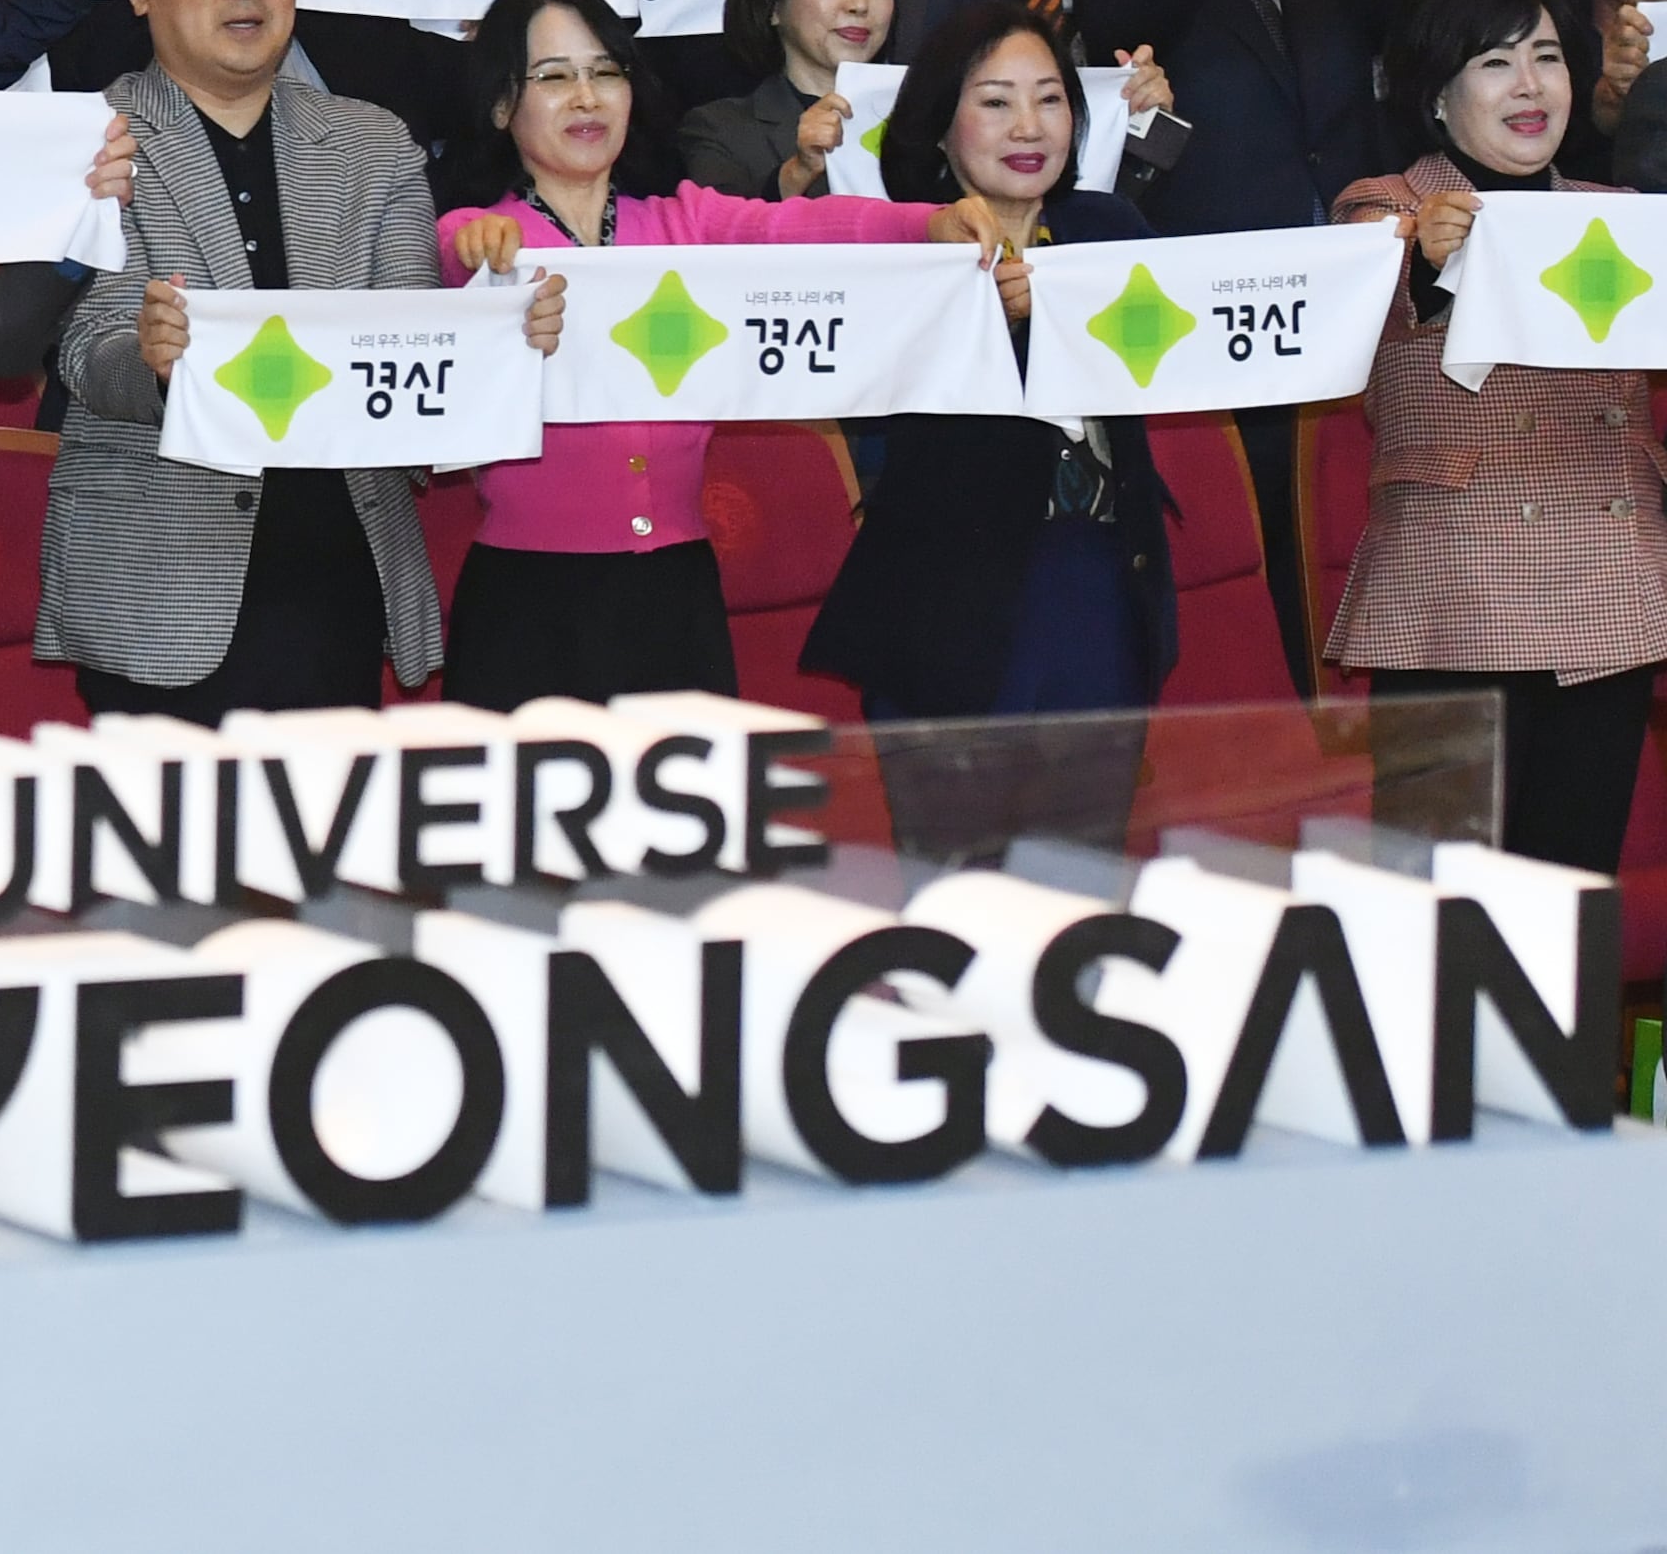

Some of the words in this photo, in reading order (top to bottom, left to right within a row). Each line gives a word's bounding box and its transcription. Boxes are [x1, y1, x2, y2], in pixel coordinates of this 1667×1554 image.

[746, 318, 843, 375] 경산
[1213, 300, 1306, 361] 경산
[351, 360, 453, 419] 경산
